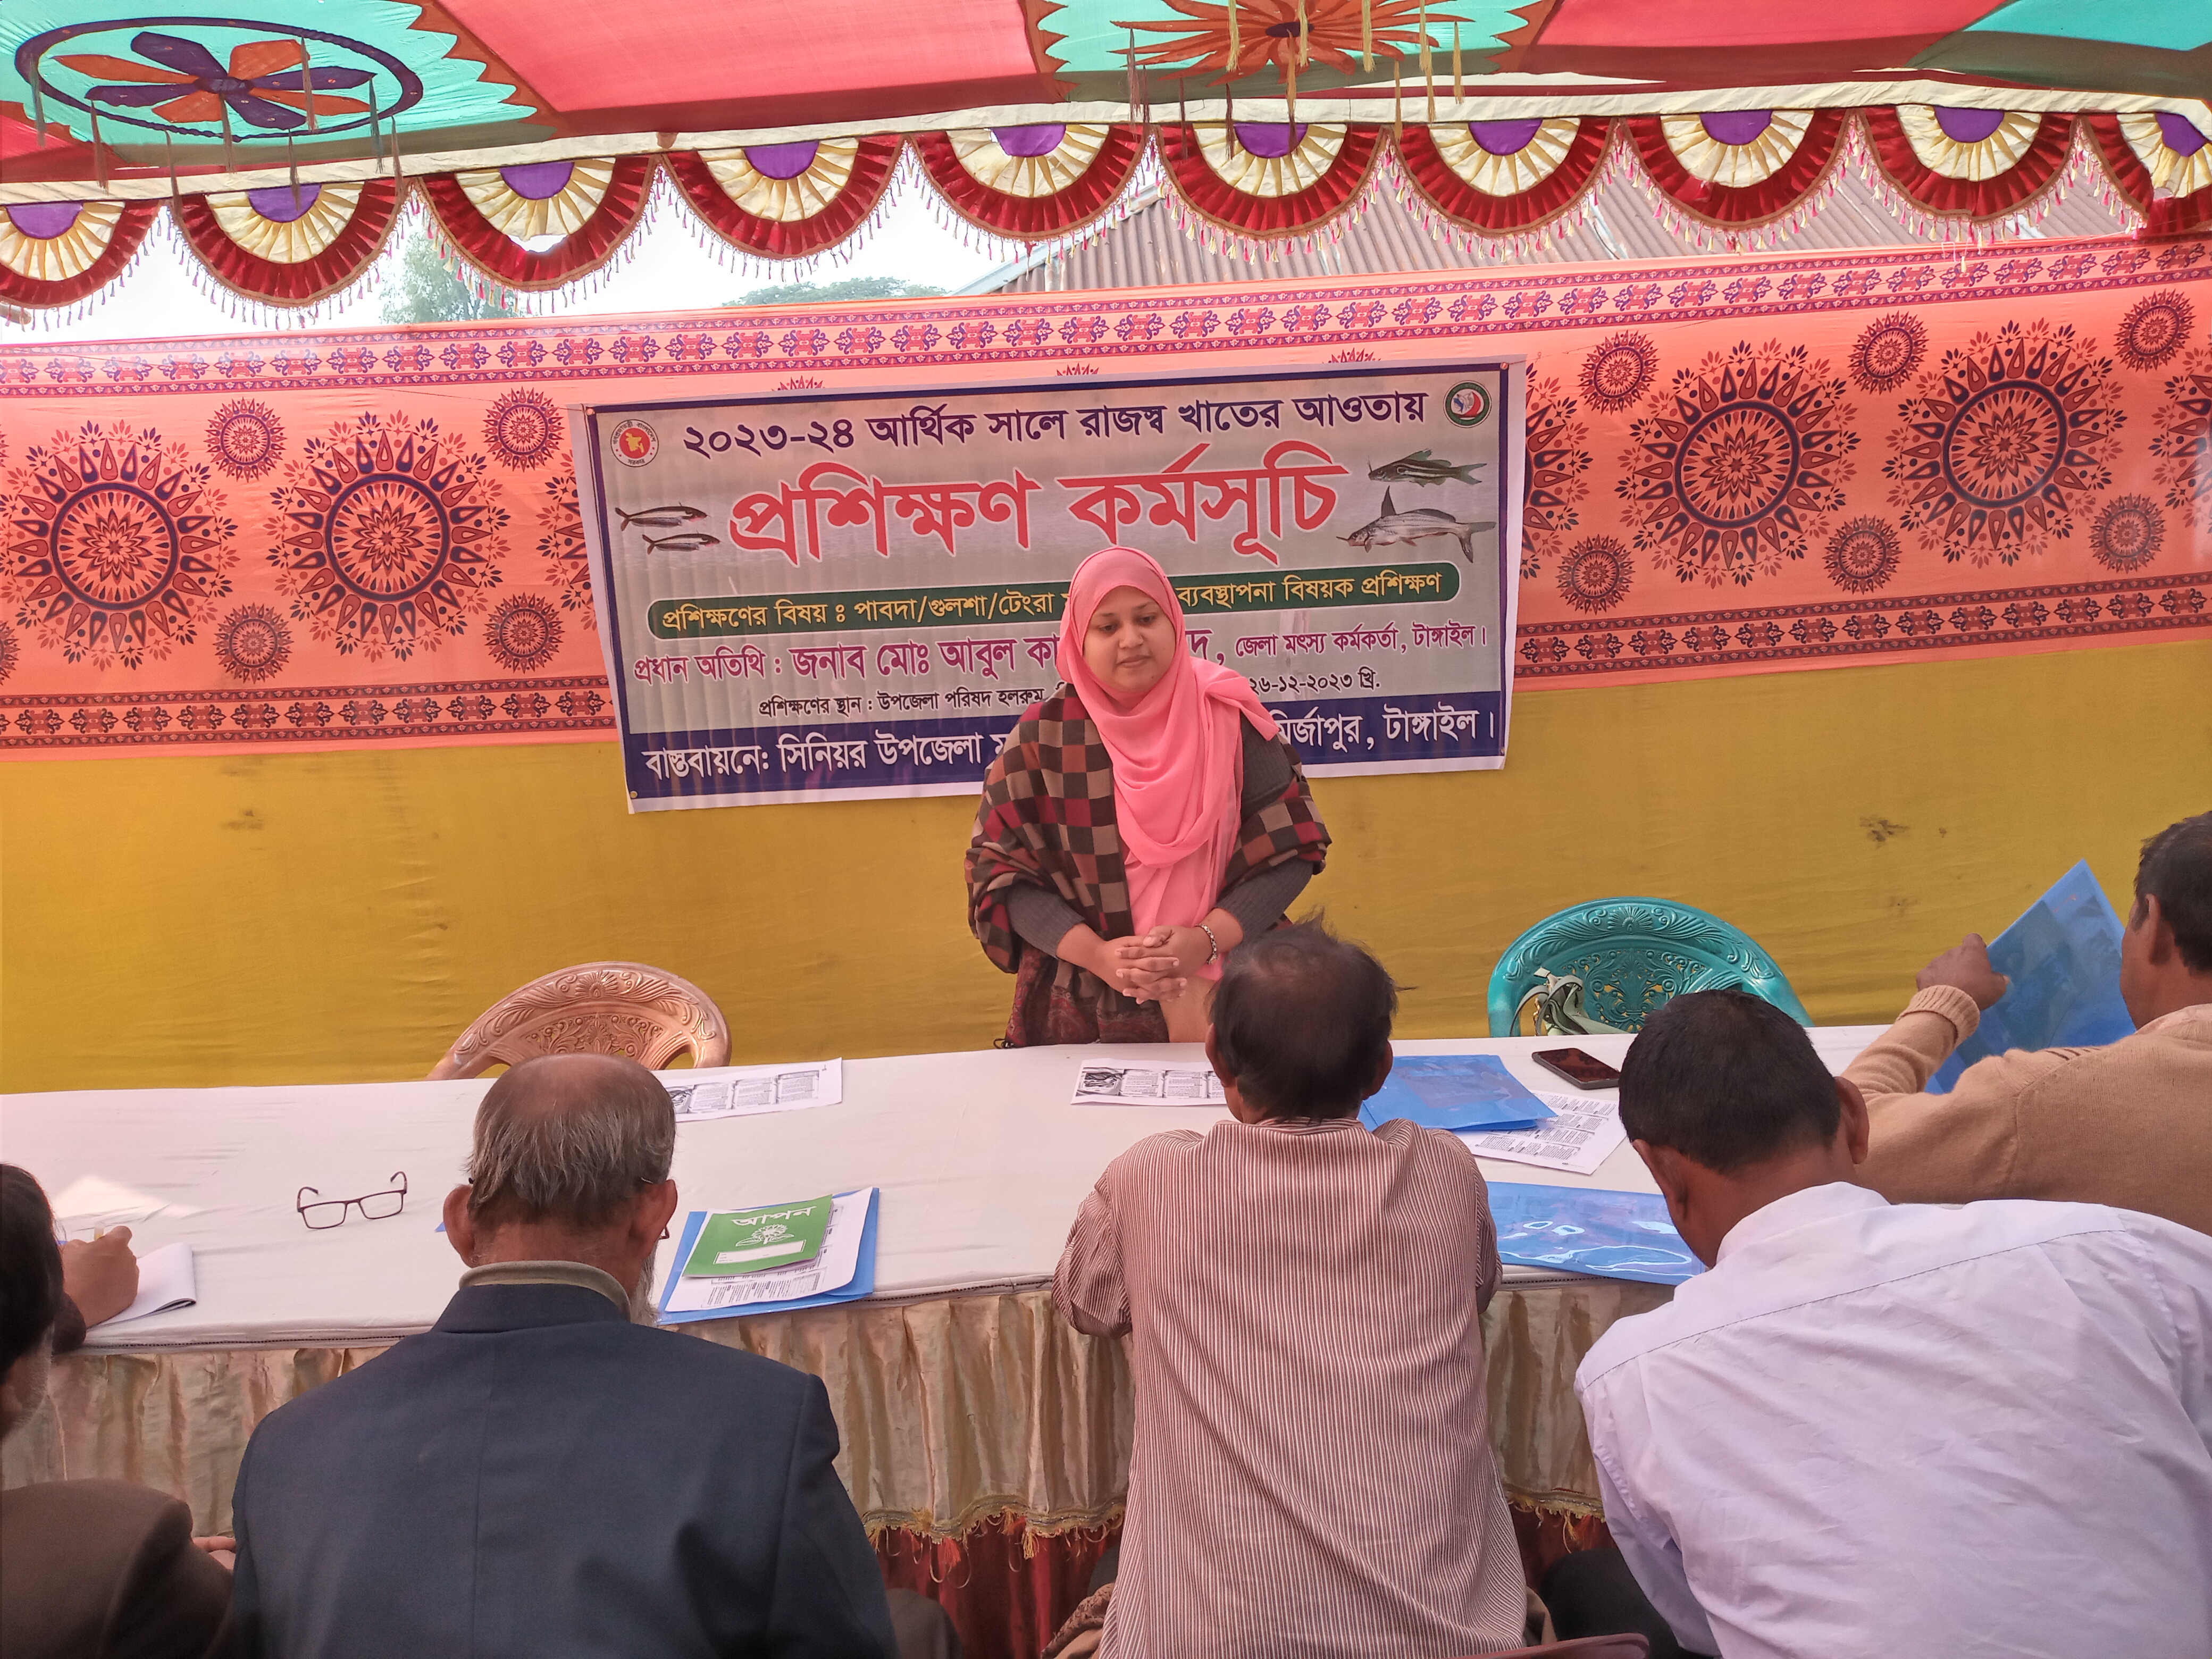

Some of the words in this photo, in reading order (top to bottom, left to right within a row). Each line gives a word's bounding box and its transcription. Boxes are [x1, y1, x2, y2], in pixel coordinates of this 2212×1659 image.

[684, 419, 855, 459] ২০২৩-২৪
[865, 404, 976, 447] আর্থিক
[985, 408, 1069, 441] সালে
[1076, 406, 1168, 437] রাজস্ব
[1179, 399, 1283, 433] খাতের
[1291, 391, 1429, 426] আওতায়
[729, 460, 1042, 567] প্রশিক্ষণ
[1056, 441, 1350, 566] কর্মসূচি
[663, 602, 767, 631] প্রশিক্ষণের
[774, 598, 829, 626] বিষয়
[854, 589, 1055, 623] পাবদা/গুলশা/টেংরা
[1175, 581, 1276, 609] ব্যবস্থাপনা
[1281, 574, 1354, 602] বিষয়ক
[1361, 569, 1443, 597] প্রশিক্ষণ
[635, 655, 689, 685] প্রধান
[694, 646, 767, 681] অতিথি
[789, 643, 868, 680] জনাব
[876, 640, 929, 676] মোঃ
[937, 636, 1018, 680] আবুল
[1235, 634, 1278, 657] জেলা
[1283, 634, 1327, 655] মৎস্য
[1333, 622, 1407, 654] কর্মকর্তা,
[1412, 619, 1476, 648] টাঙ্গাইল
[759, 696, 830, 717] প্রশিক্ষণের
[834, 697, 862, 717] স্থান
[877, 690, 940, 711] উপজেলা
[944, 687, 992, 710] পরিষদ
[776, 732, 868, 773] সিনিয়র
[874, 729, 985, 767] উপজেলা
[1382, 701, 1480, 742] টাঙ্গাইল
[731, 1206, 817, 1226] আপন
